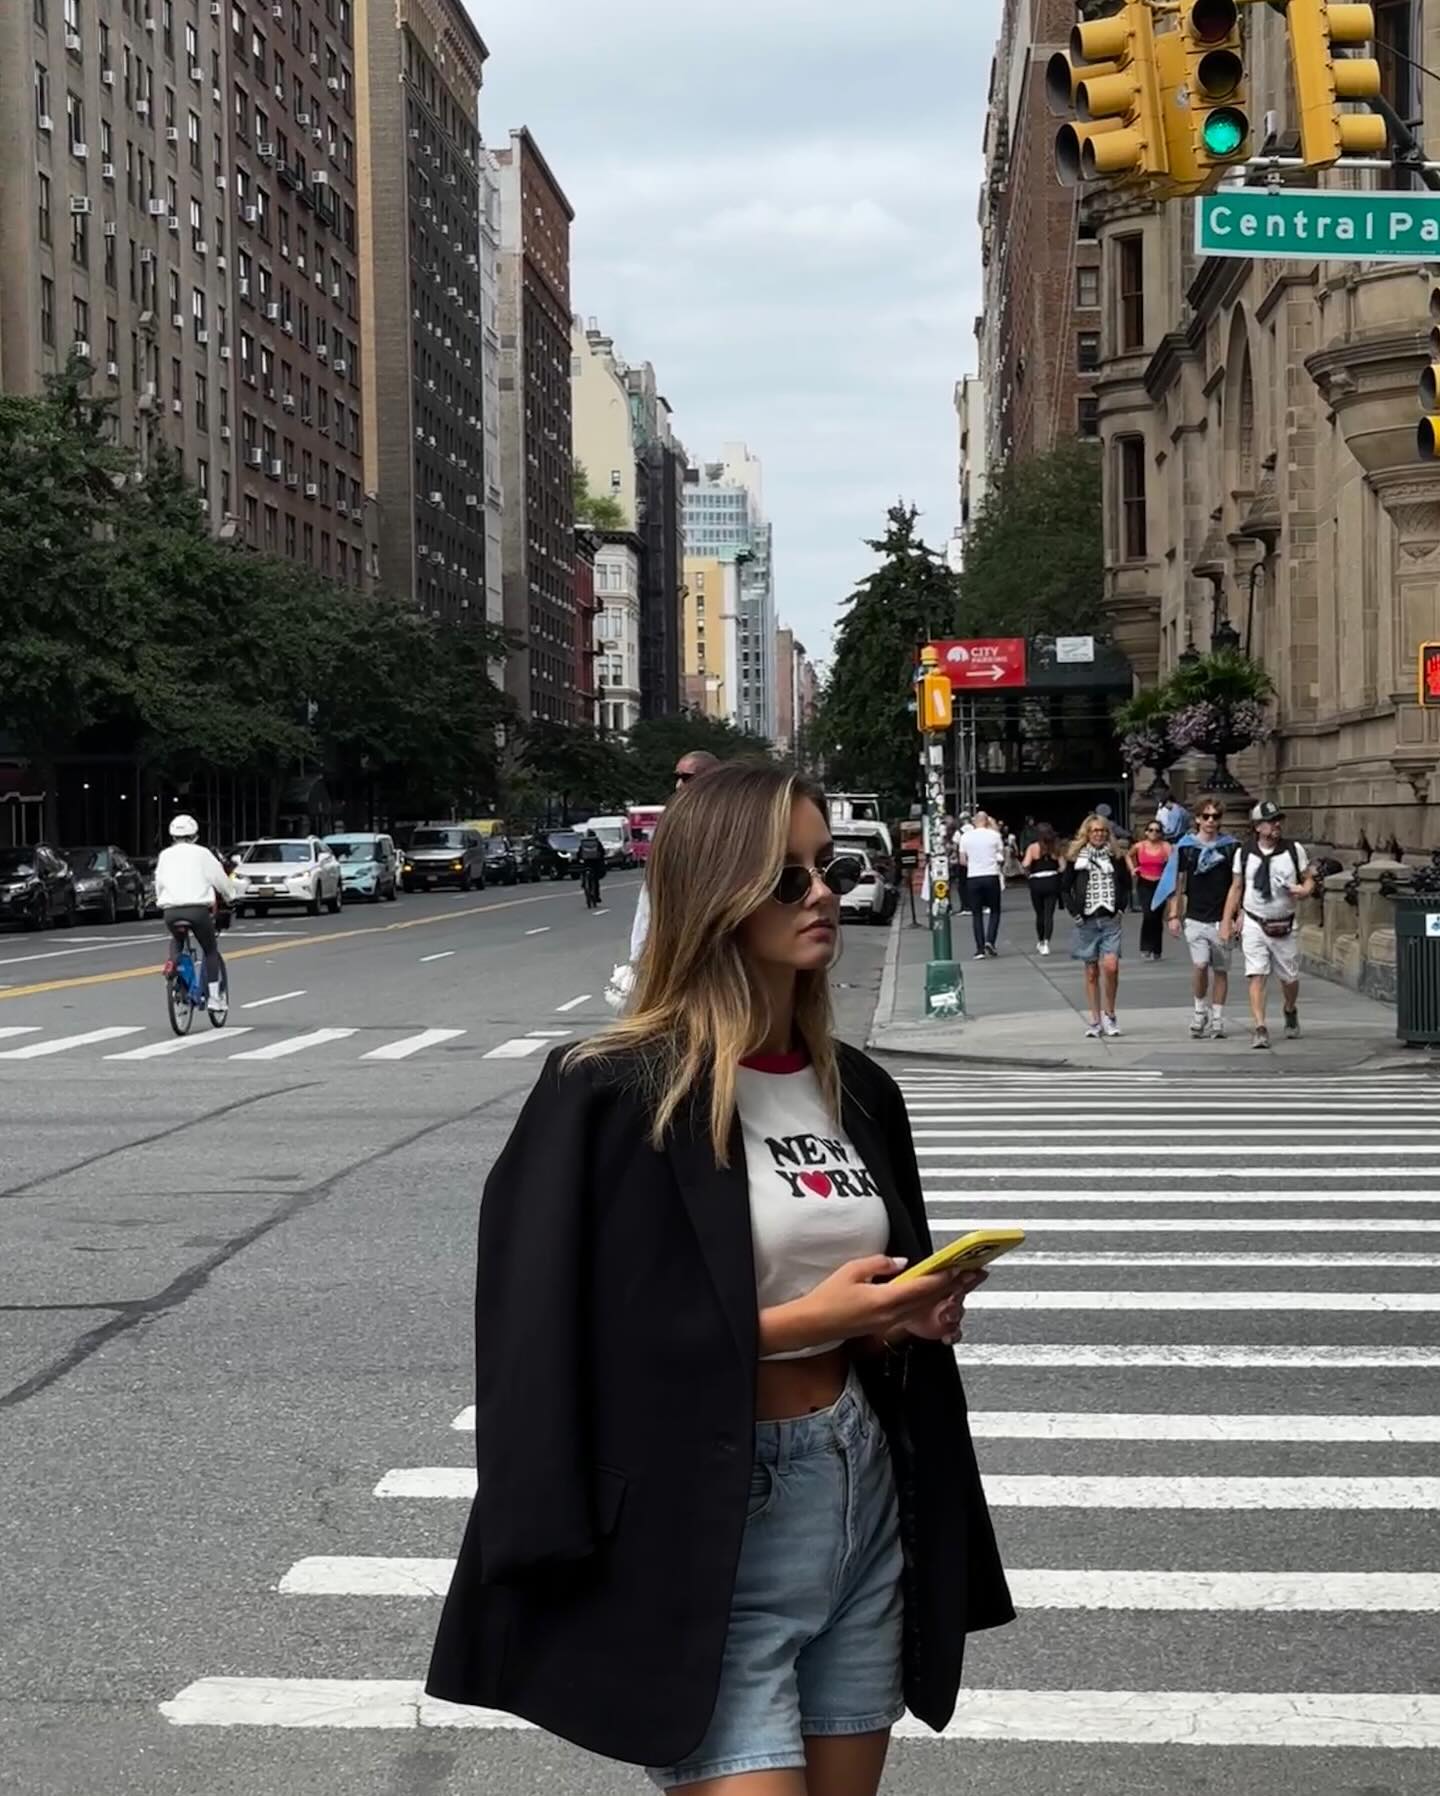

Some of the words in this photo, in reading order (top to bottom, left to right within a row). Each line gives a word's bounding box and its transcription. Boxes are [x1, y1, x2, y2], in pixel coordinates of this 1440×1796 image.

[1209, 206, 1374, 240] Central
[970, 647, 999, 657] CITY
[764, 1133, 849, 1167] NEW
